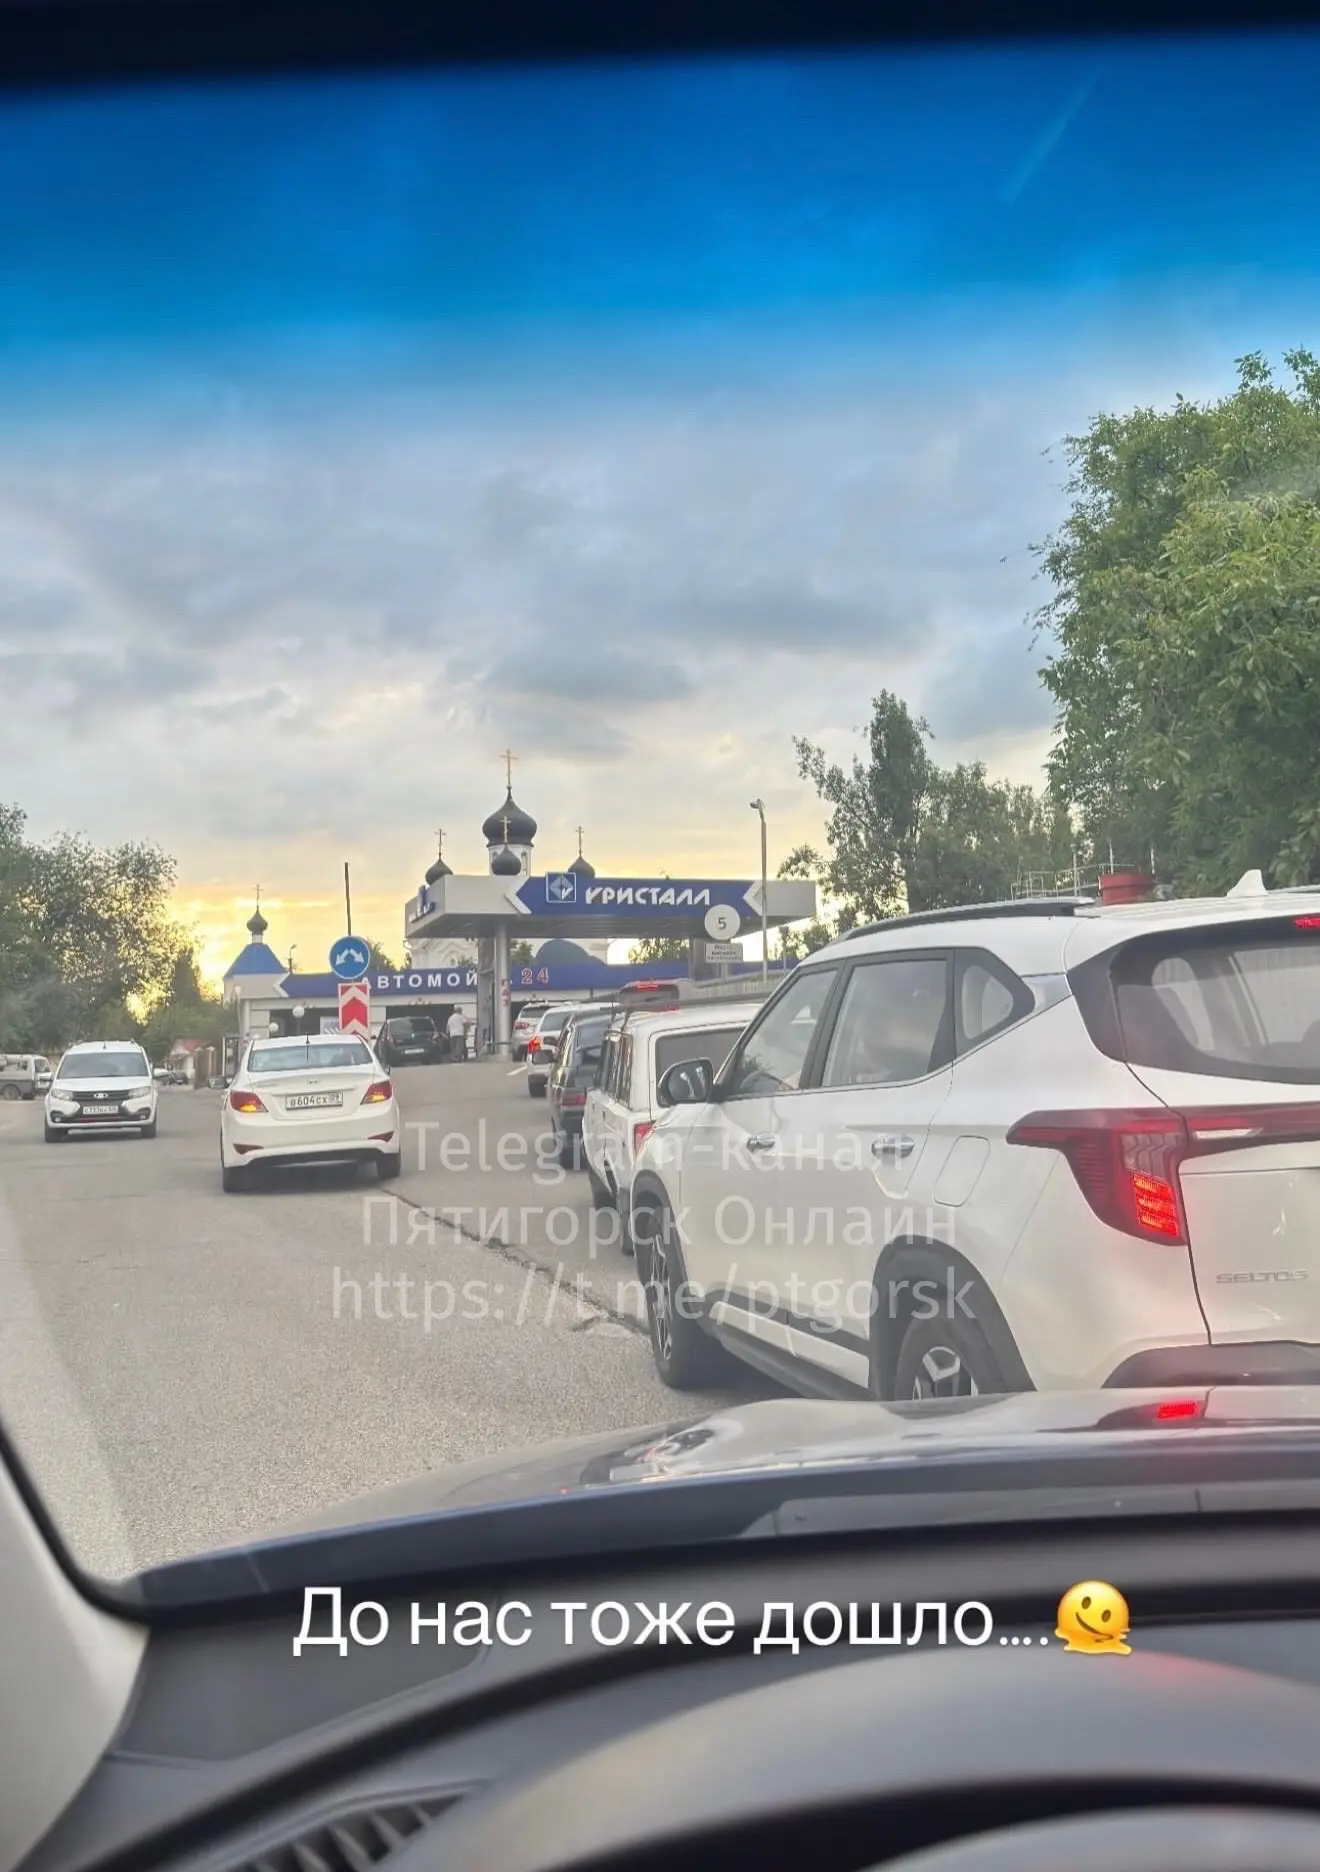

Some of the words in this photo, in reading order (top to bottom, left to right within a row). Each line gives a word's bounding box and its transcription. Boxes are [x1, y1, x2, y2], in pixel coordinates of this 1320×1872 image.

[585, 887, 710, 906] КРИСТАЛЛ
[718, 916, 727, 930] 5
[360, 969, 513, 990] АВТОМОЙ
[521, 967, 549, 984] 24
[1216, 1268, 1309, 1284] SELTOS
